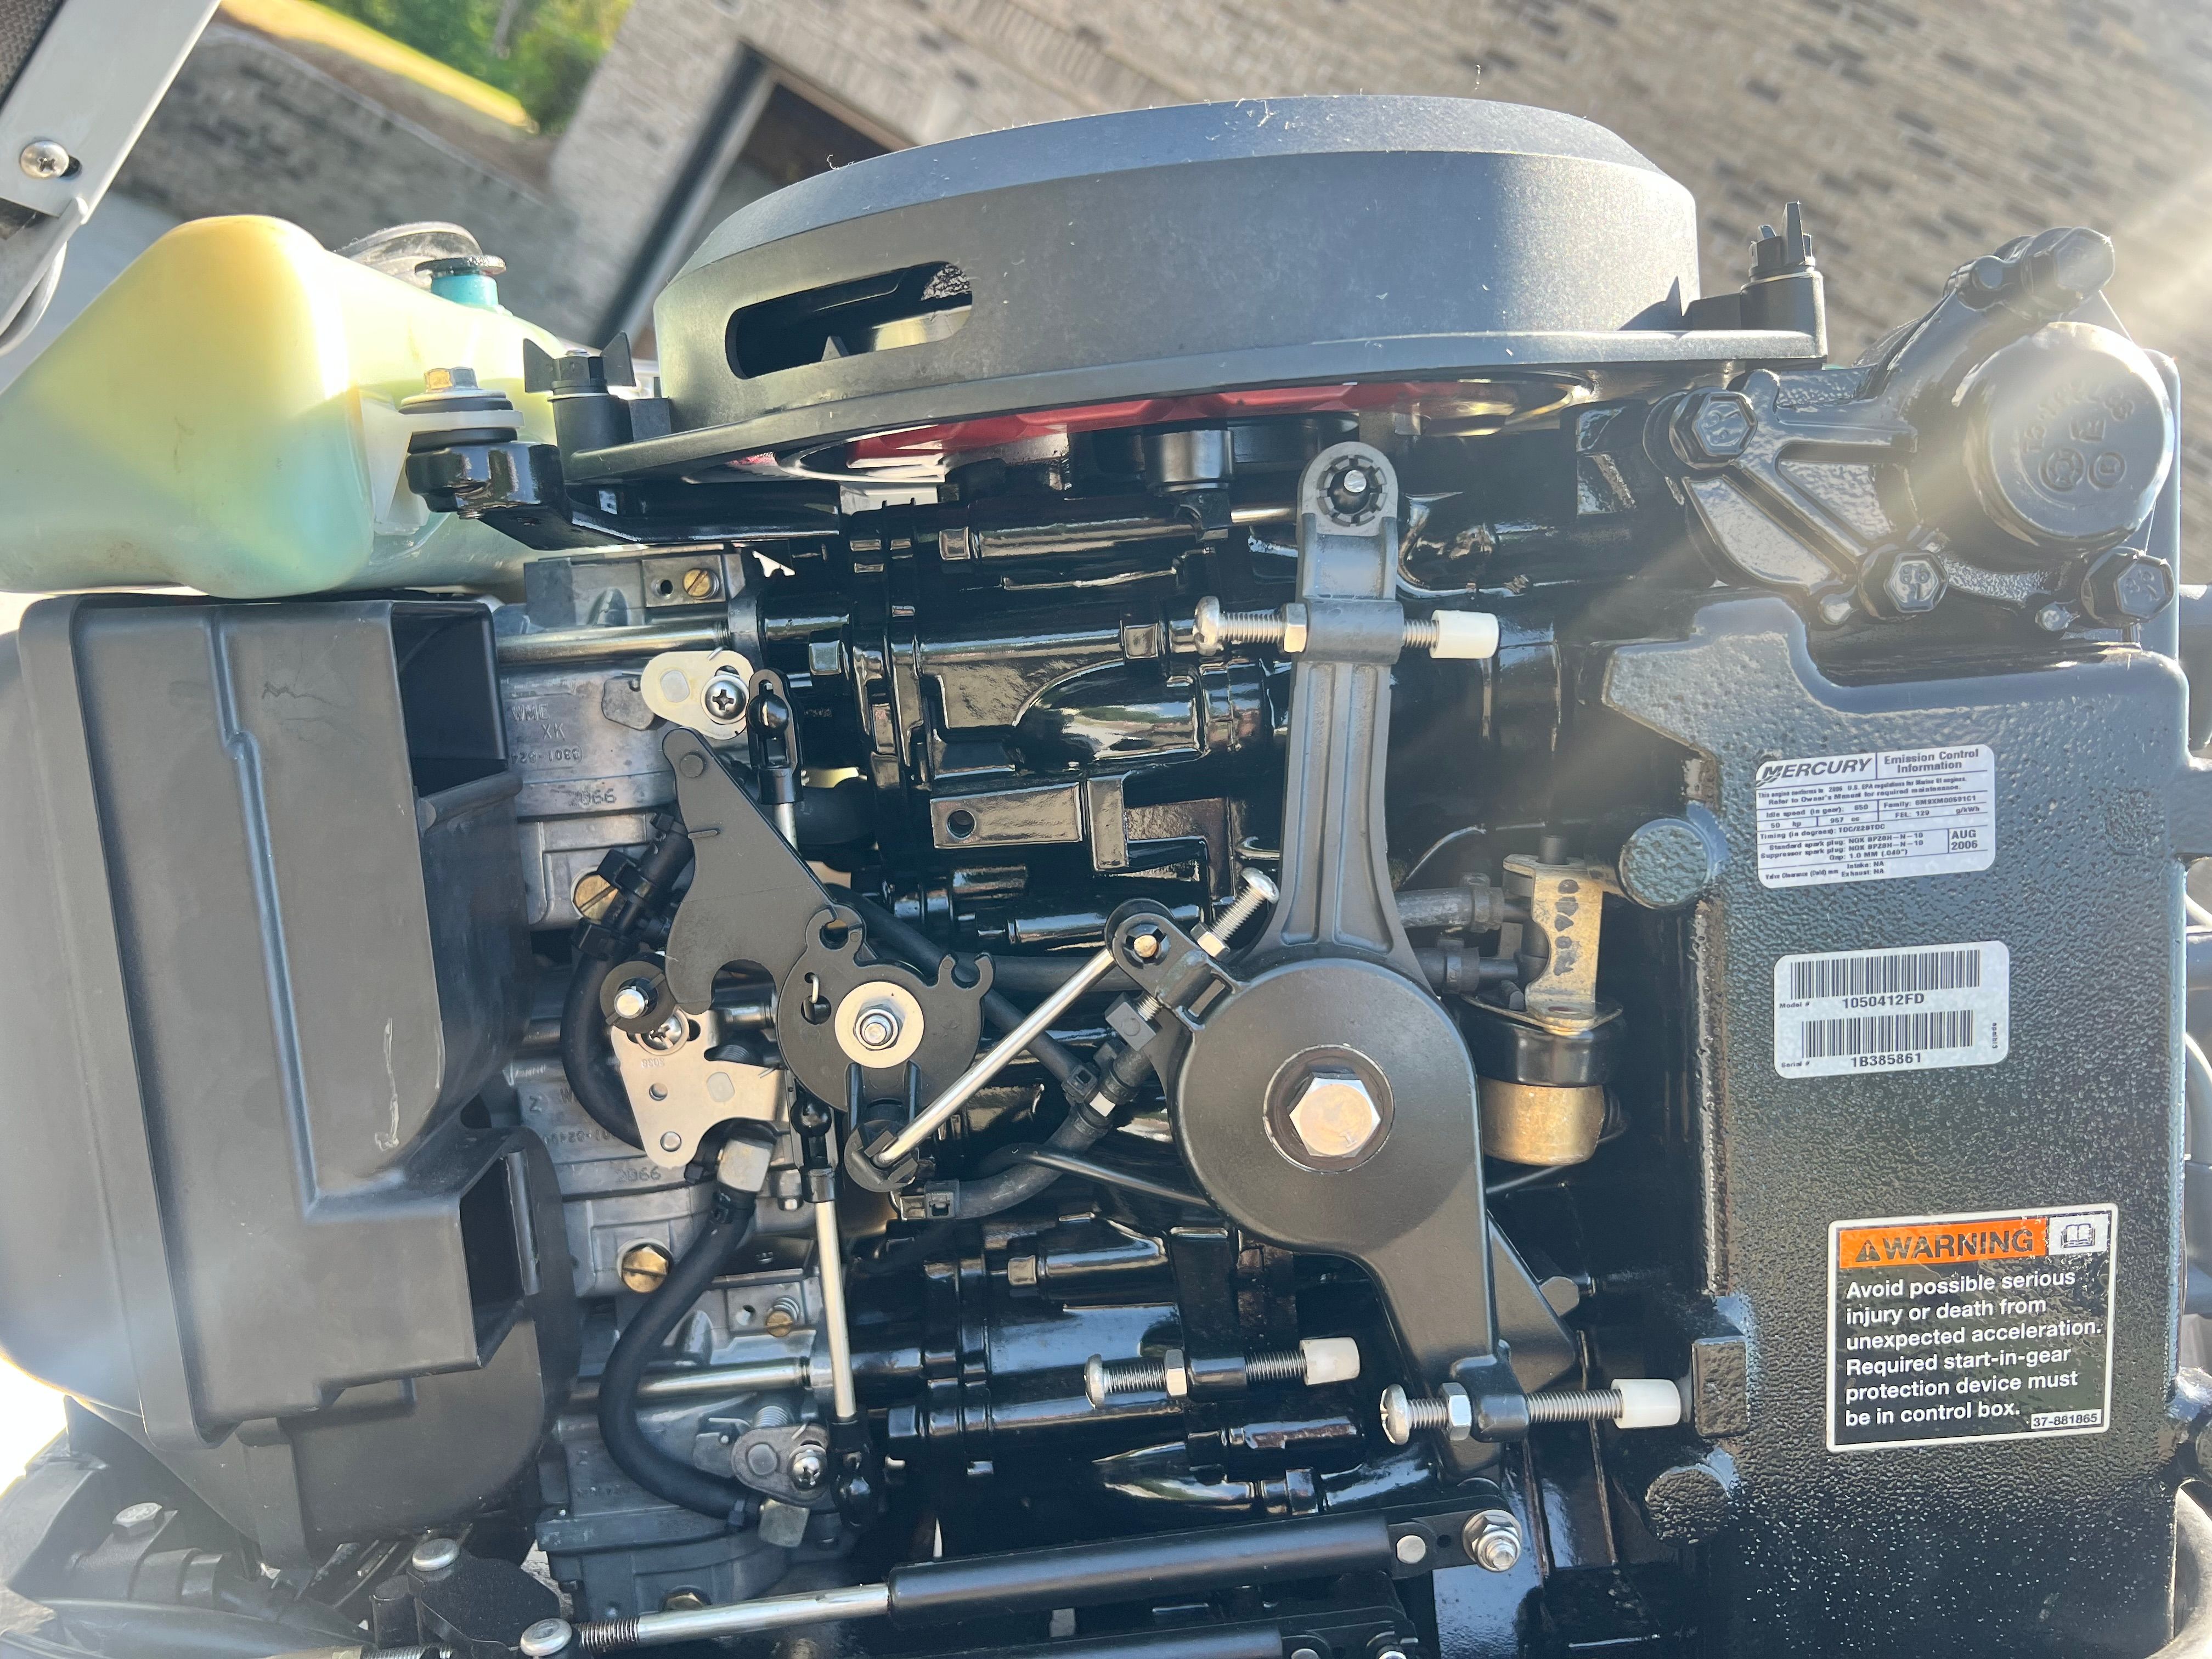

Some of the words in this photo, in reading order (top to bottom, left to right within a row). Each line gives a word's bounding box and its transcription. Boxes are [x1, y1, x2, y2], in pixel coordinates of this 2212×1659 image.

[1884, 753, 1935, 765] Emission
[1939, 749, 1979, 760] Control
[1761, 758, 1873, 780] MERCURY
[1897, 761, 1962, 773] Information
[1876, 788, 1909, 797] required
[1883, 800, 1911, 809] Family:
[1760, 832, 1786, 840] Timing
[1951, 829, 1977, 839] AUG
[1760, 851, 1802, 859] Suppressor
[1827, 847, 1846, 855] plug:
[1769, 843, 1802, 851] Standard
[1826, 840, 1846, 848] plug:
[1951, 840, 1978, 850] 2006
[1841, 869, 1871, 877] Exhaust:
[1842, 993, 1925, 1009] 1050412FD
[1850, 1052, 1922, 1068] 1B385861
[1883, 1229, 2033, 1260] WARNING
[1846, 1279, 1904, 1299] Avoid
[1909, 1273, 1995, 1300] possible
[2001, 1269, 2076, 1289] serious
[1846, 1307, 1903, 1327] injury
[1909, 1306, 1931, 1320] or
[1936, 1300, 1994, 1319] death
[1999, 1296, 2046, 1314] from
[1846, 1326, 1965, 1351] unexpected
[1971, 1320, 2101, 1342] acceleration.
[1846, 1353, 1938, 1377] Required
[1944, 1346, 2072, 1370] start-in-gear
[1846, 1379, 1950, 1404] protection
[1956, 1375, 2022, 1396] device
[2028, 1370, 2079, 1390] must
[1846, 1409, 1870, 1426] be
[1876, 1407, 1894, 1425] in
[1900, 1401, 1972, 1422] control
[1978, 1400, 2021, 1418] box.
[2033, 1413, 2098, 1427] 37-881865
